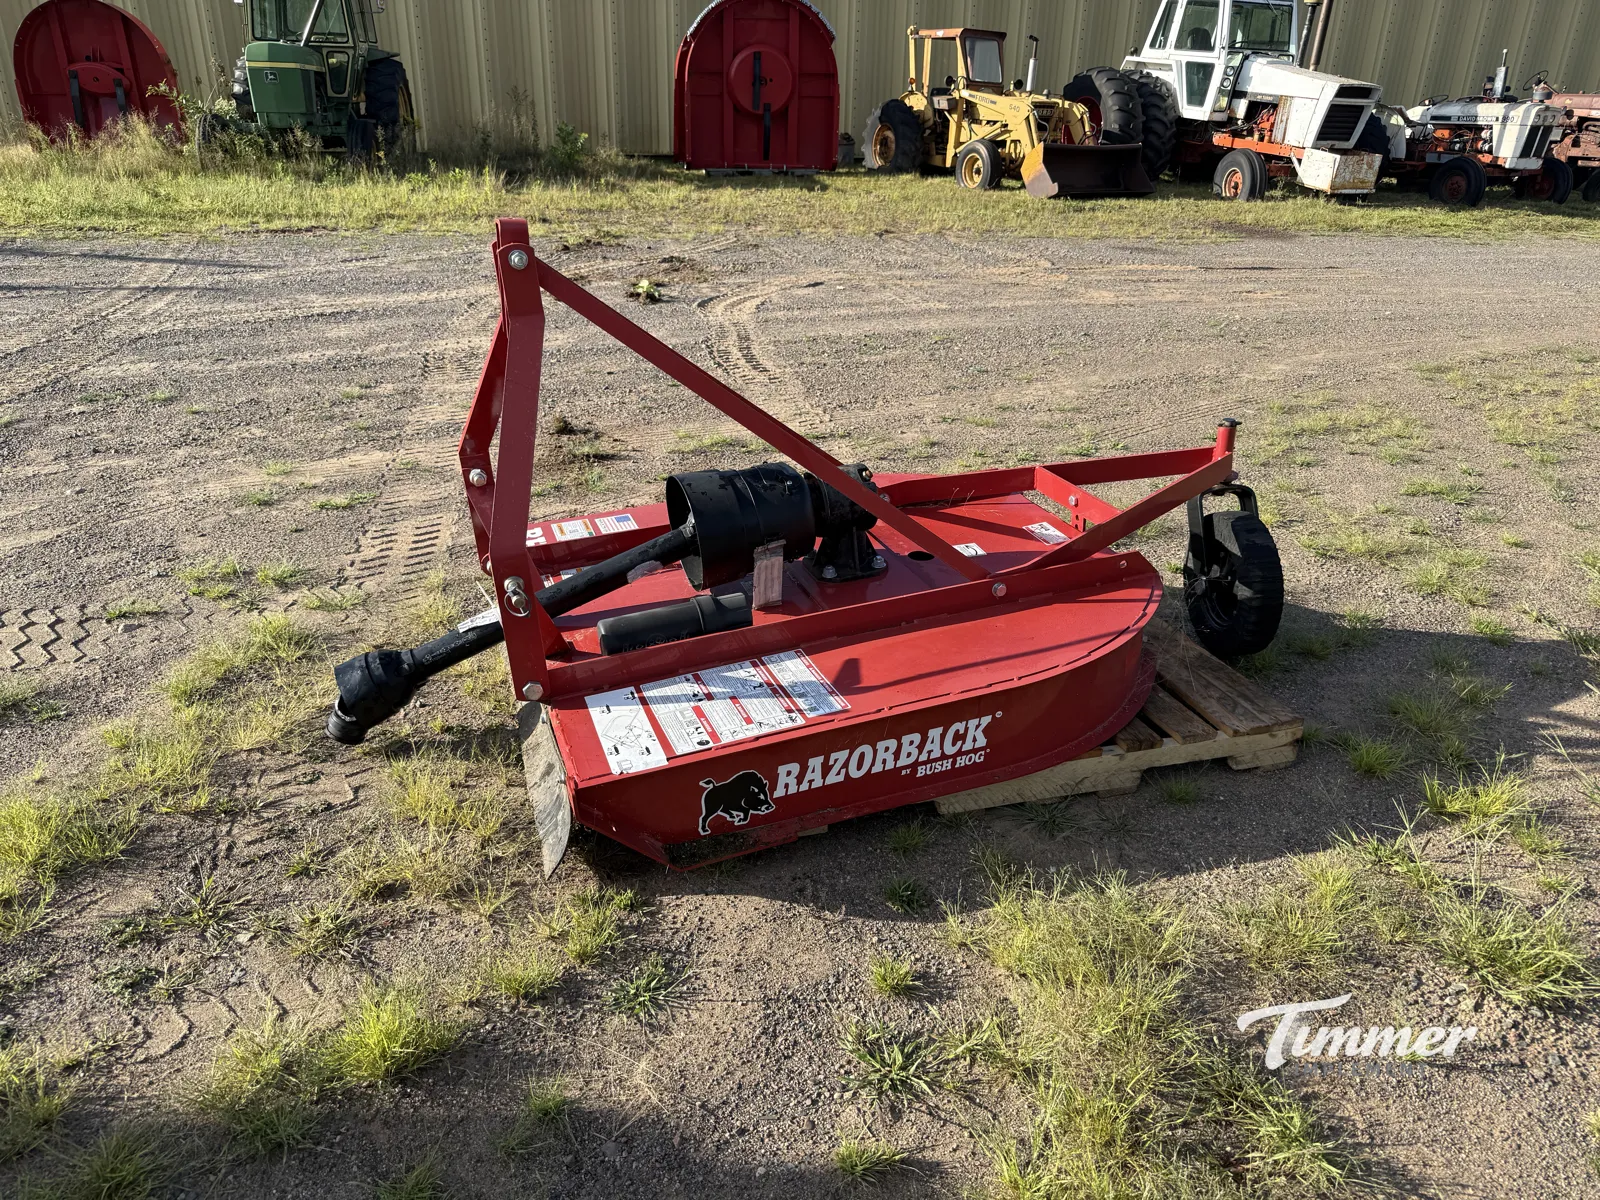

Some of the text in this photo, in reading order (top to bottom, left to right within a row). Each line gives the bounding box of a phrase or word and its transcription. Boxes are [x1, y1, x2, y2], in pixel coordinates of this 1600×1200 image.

[773, 714, 993, 799] RAZORBACK
[901, 751, 985, 778] BY BUSH HOG
